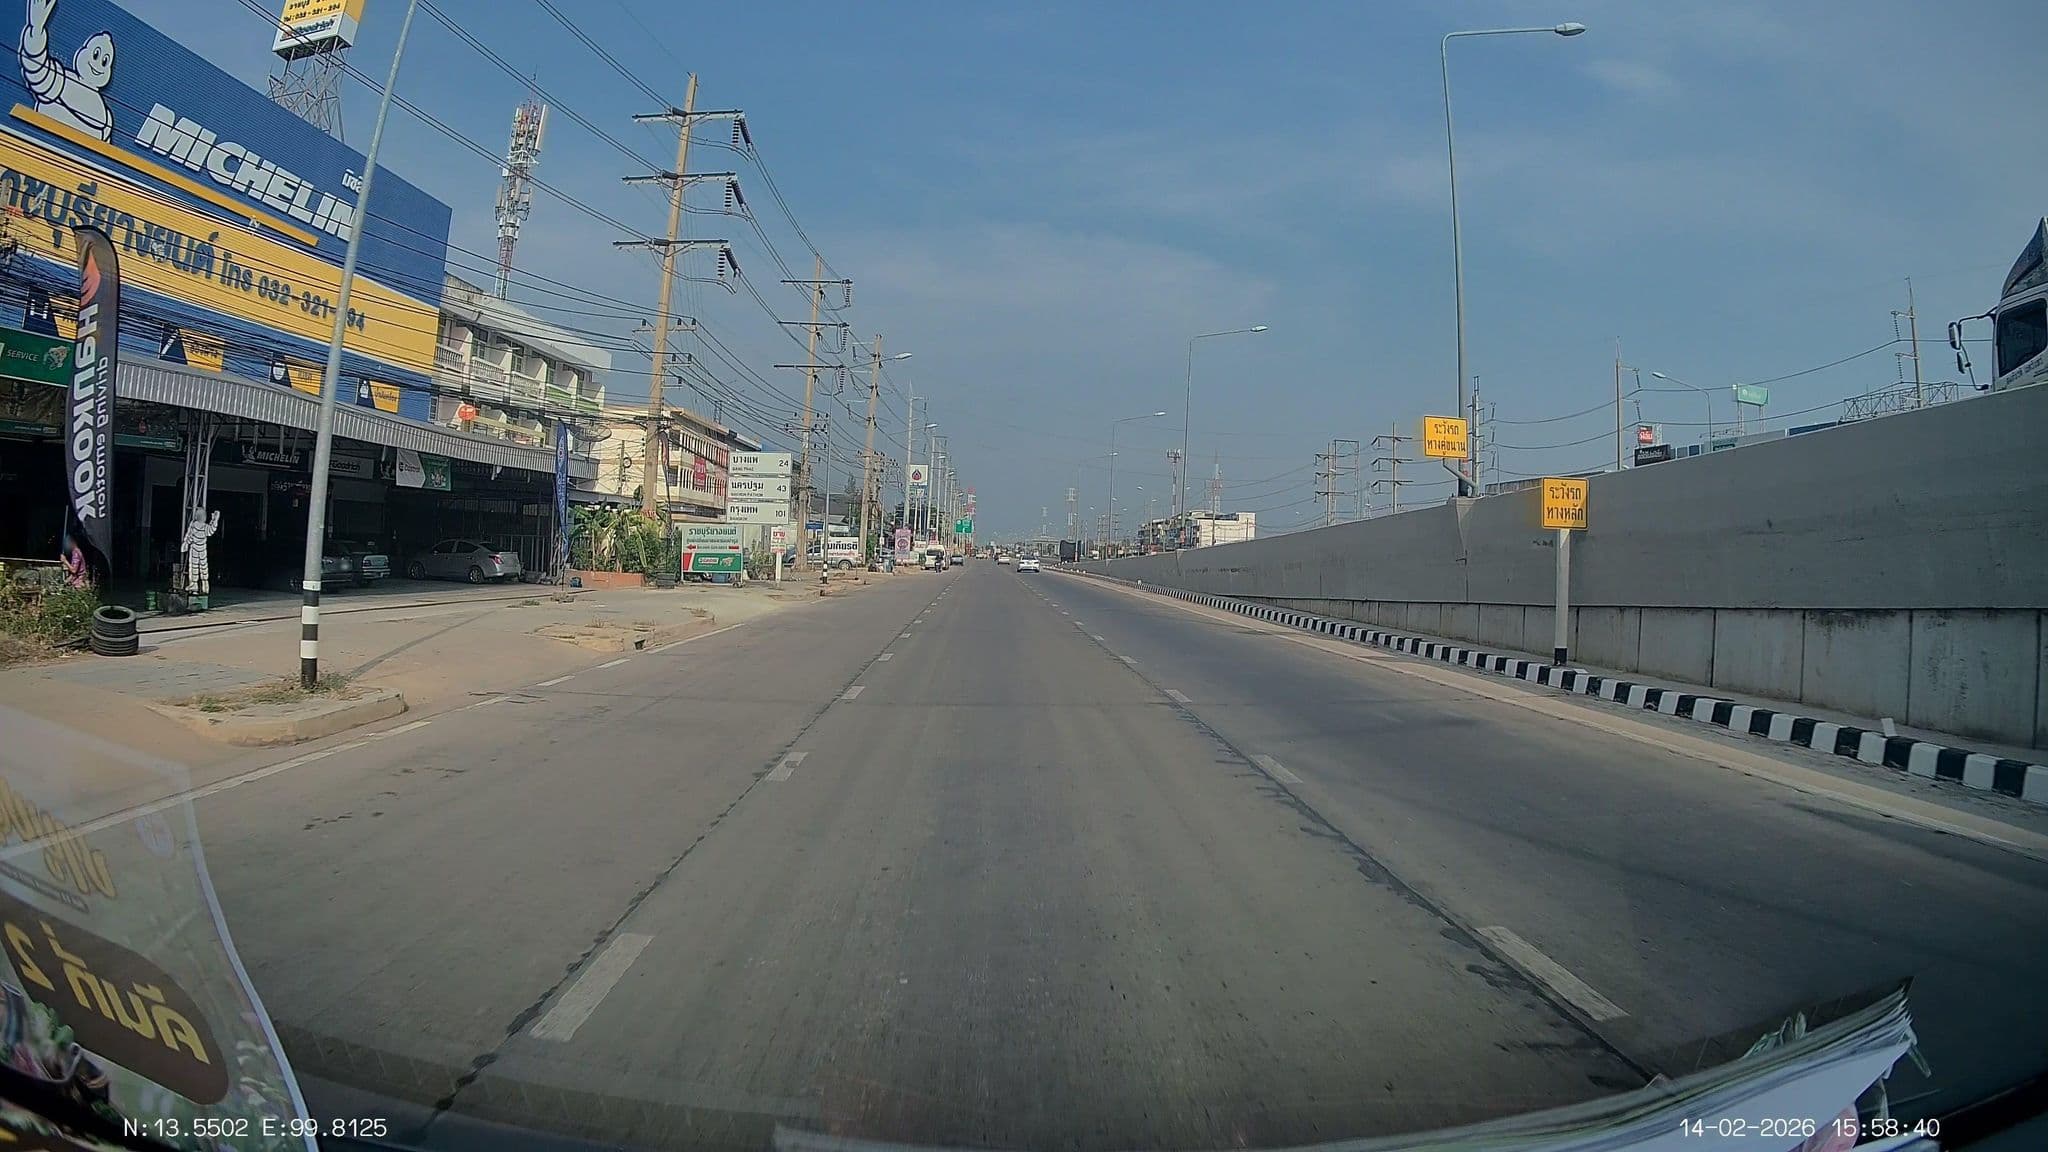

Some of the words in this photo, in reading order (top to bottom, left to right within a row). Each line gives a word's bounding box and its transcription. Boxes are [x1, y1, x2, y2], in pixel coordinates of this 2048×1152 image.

[134, 103, 358, 243] MICHELIN
[219, 251, 253, 292] โทร
[258, 275, 365, 332] 032-321-94
[7, 349, 39, 362] SERVICE
[1434, 420, 1459, 435] ระวังรถ
[1427, 436, 1466, 455] ทางคู่ขนาน
[256, 450, 300, 464] MICHELIN
[732, 456, 758, 464] บางแพ
[778, 459, 789, 467] 24
[731, 480, 764, 492] นครปฐม
[776, 484, 787, 493] 43
[1549, 482, 1582, 500] ระวังรถ
[730, 505, 758, 516] กรุงเทพ
[775, 510, 786, 518] 101
[1546, 502, 1584, 523] ทางหลัก
